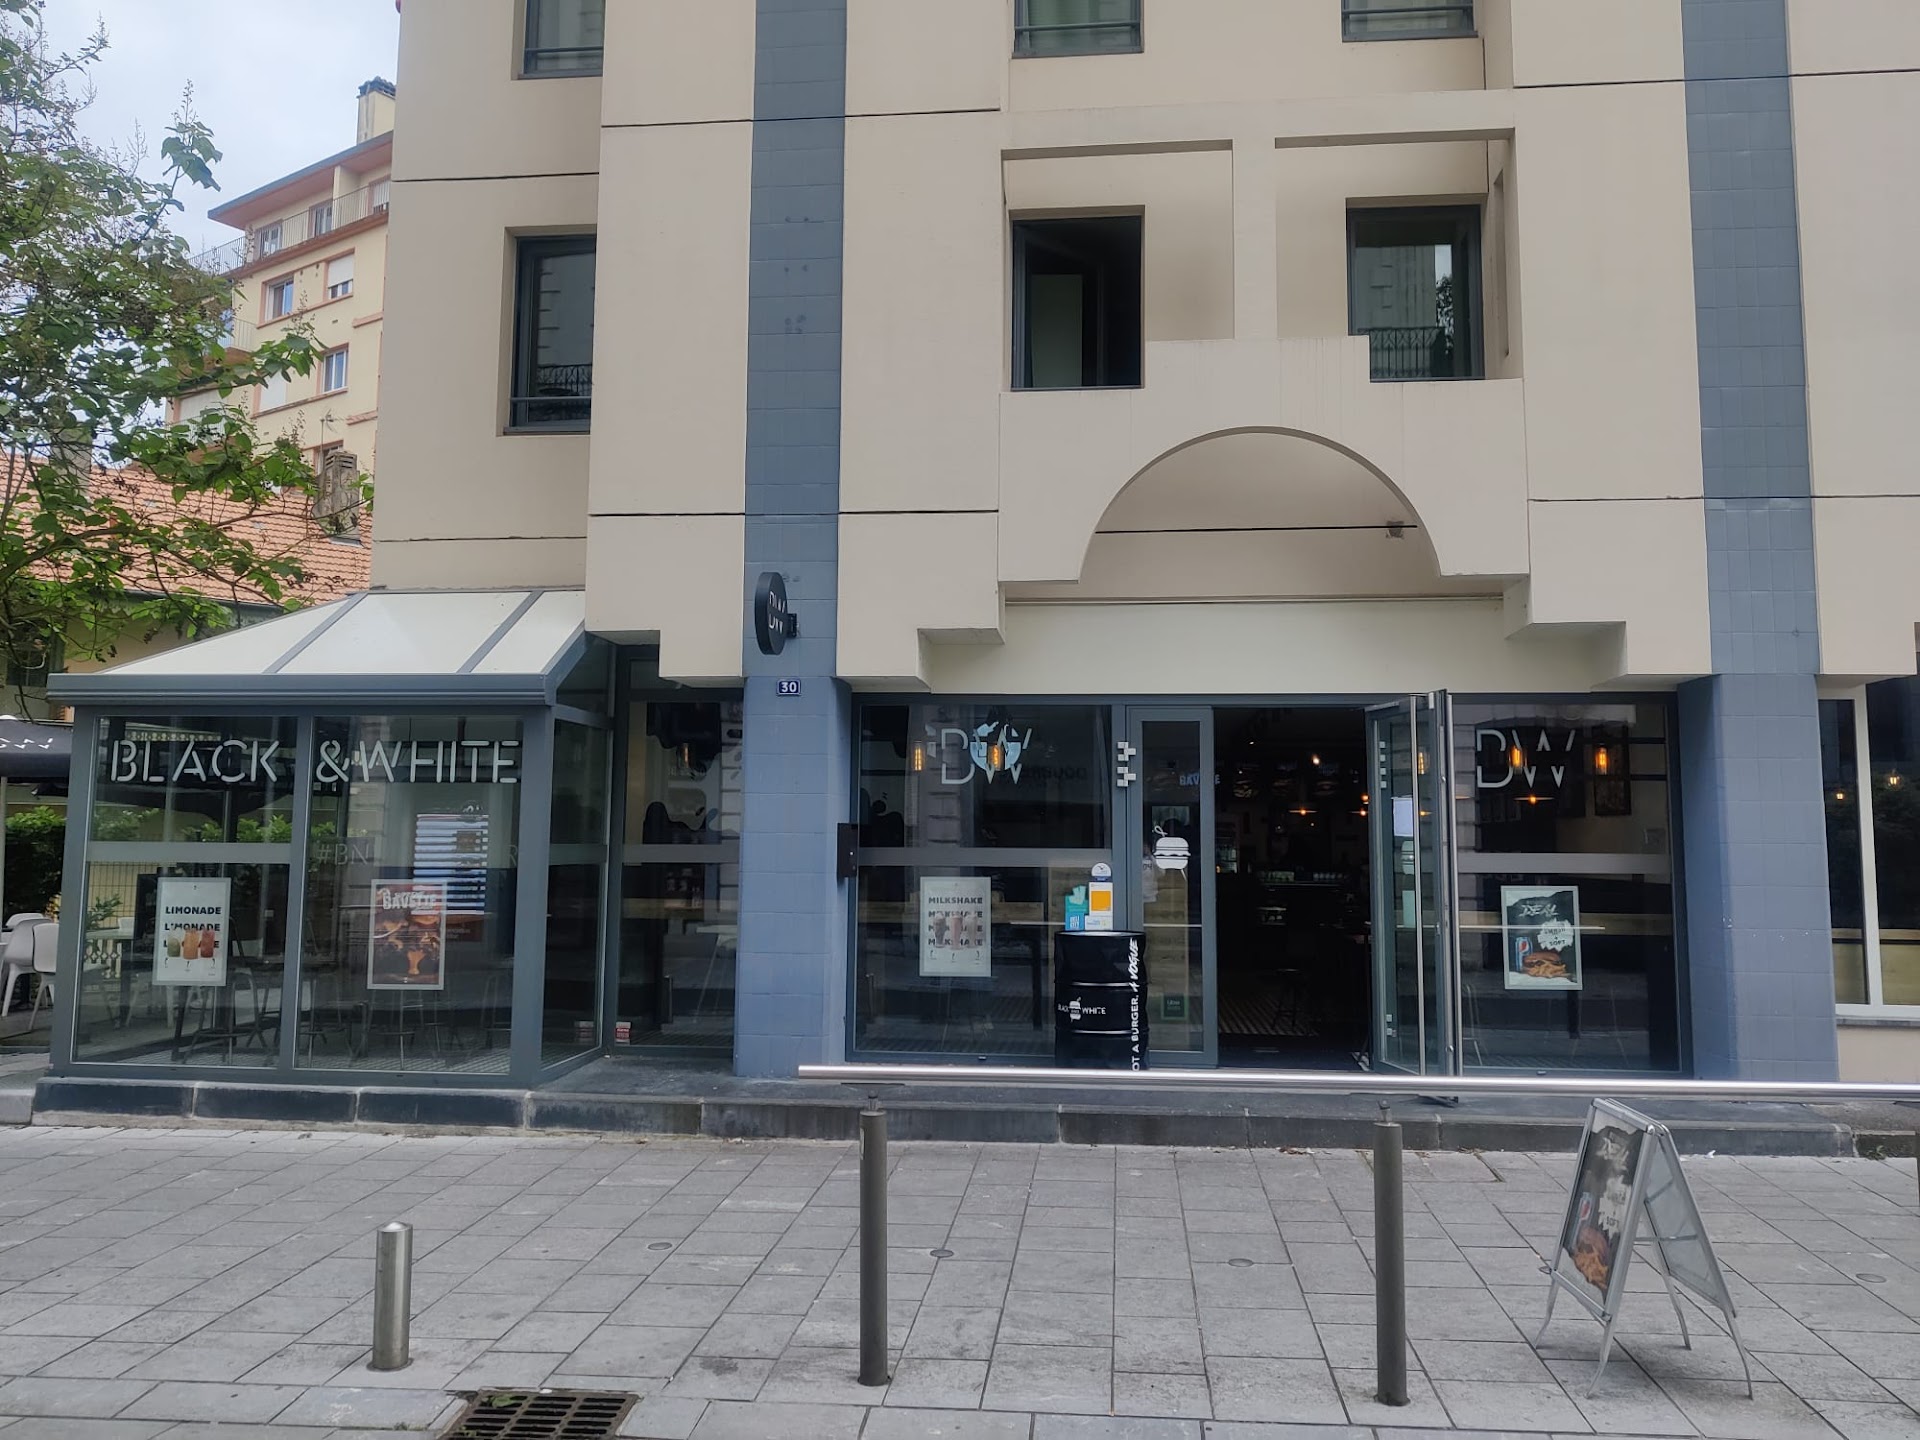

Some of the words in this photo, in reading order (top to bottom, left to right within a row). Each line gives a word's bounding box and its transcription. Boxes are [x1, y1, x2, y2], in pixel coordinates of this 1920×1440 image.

[781, 682, 797, 692] 30
[111, 740, 279, 782] BLACK
[1476, 729, 1576, 788] DW
[165, 906, 222, 914] LIMONADE
[1082, 1007, 1106, 1015] WHITE
[1131, 995, 1139, 1042] BURGER.
[1131, 1044, 1140, 1053] A
